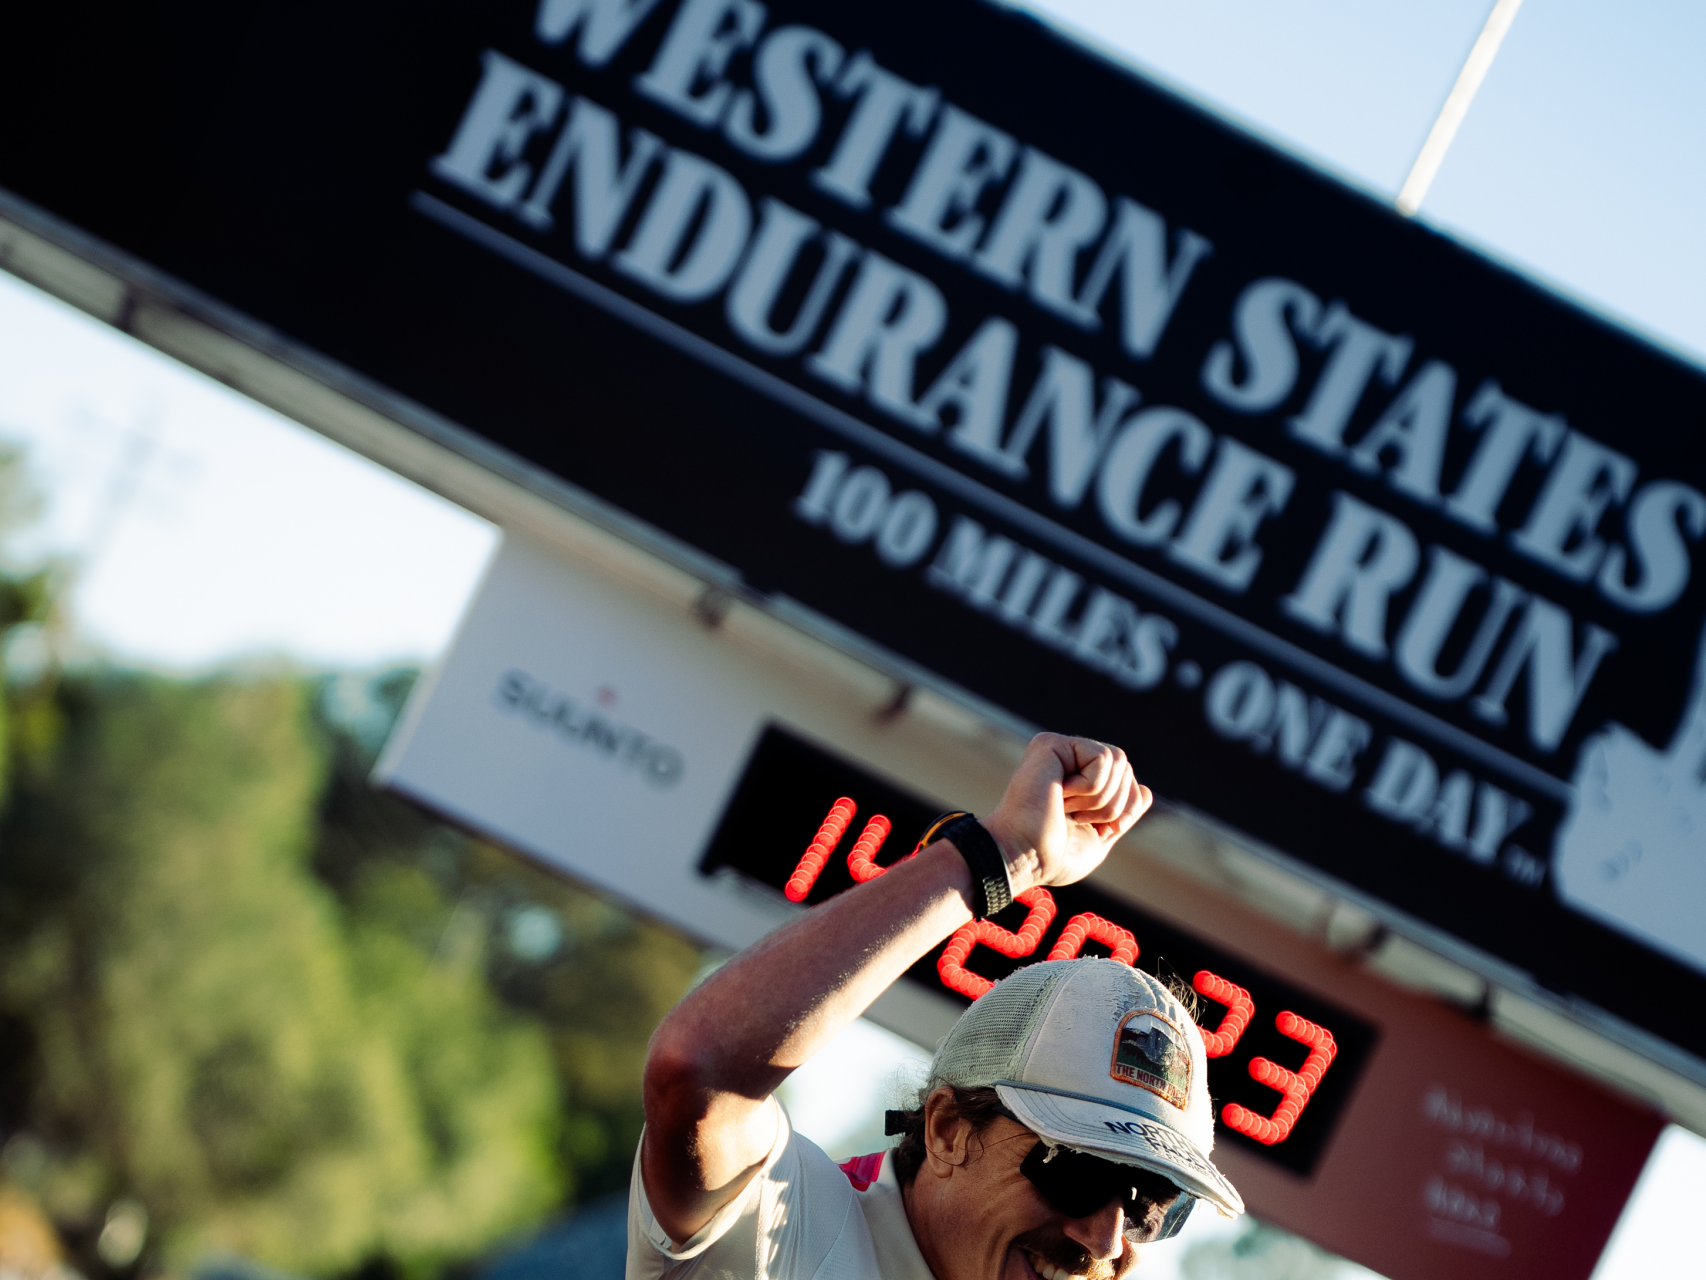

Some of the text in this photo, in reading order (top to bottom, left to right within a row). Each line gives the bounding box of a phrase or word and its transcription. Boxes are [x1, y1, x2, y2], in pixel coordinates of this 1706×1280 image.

[430, 48, 1618, 753] ENDURANCE RUN
[1202, 276, 1706, 612] STATES
[795, 450, 1533, 864] 100 MILES ONE DAY
[1103, 1121, 1194, 1151] NORTH
[1115, 1063, 1134, 1078] THE
[1136, 1068, 1166, 1090] NORTH
